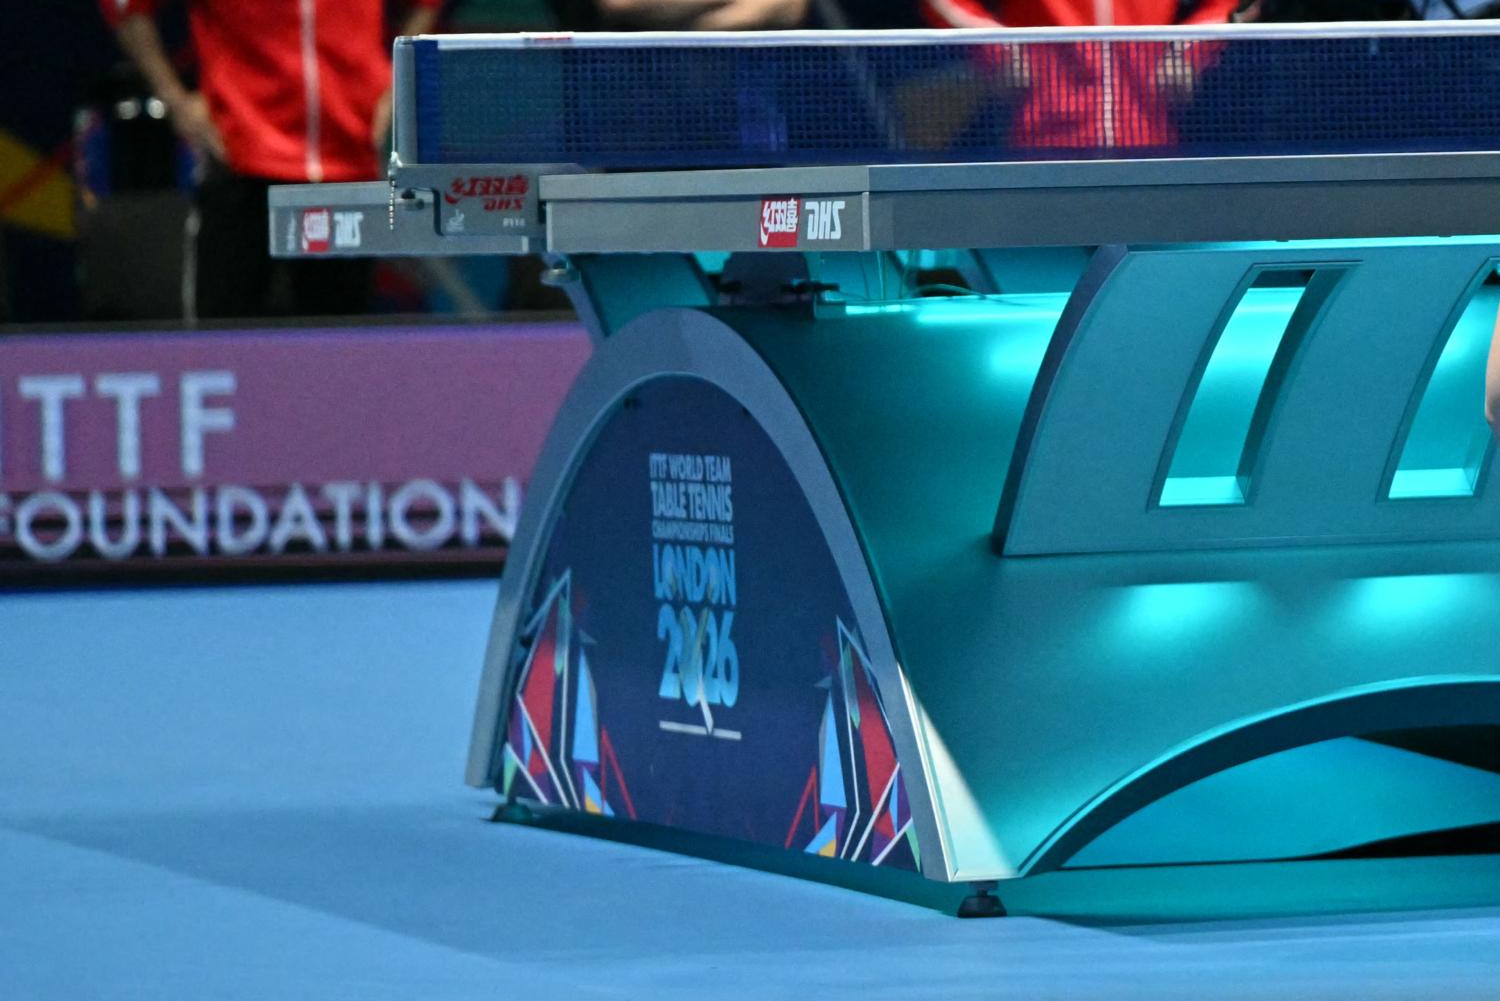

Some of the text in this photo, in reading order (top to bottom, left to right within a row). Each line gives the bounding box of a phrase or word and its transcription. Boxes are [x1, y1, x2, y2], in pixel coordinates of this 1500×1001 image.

[804, 200, 846, 240] DHS
[0, 370, 239, 483] TTF
[0, 478, 521, 561] OUNDATION
[687, 482, 734, 522] TENNIS
[652, 543, 737, 606] LONDON
[657, 603, 740, 709] 2026
